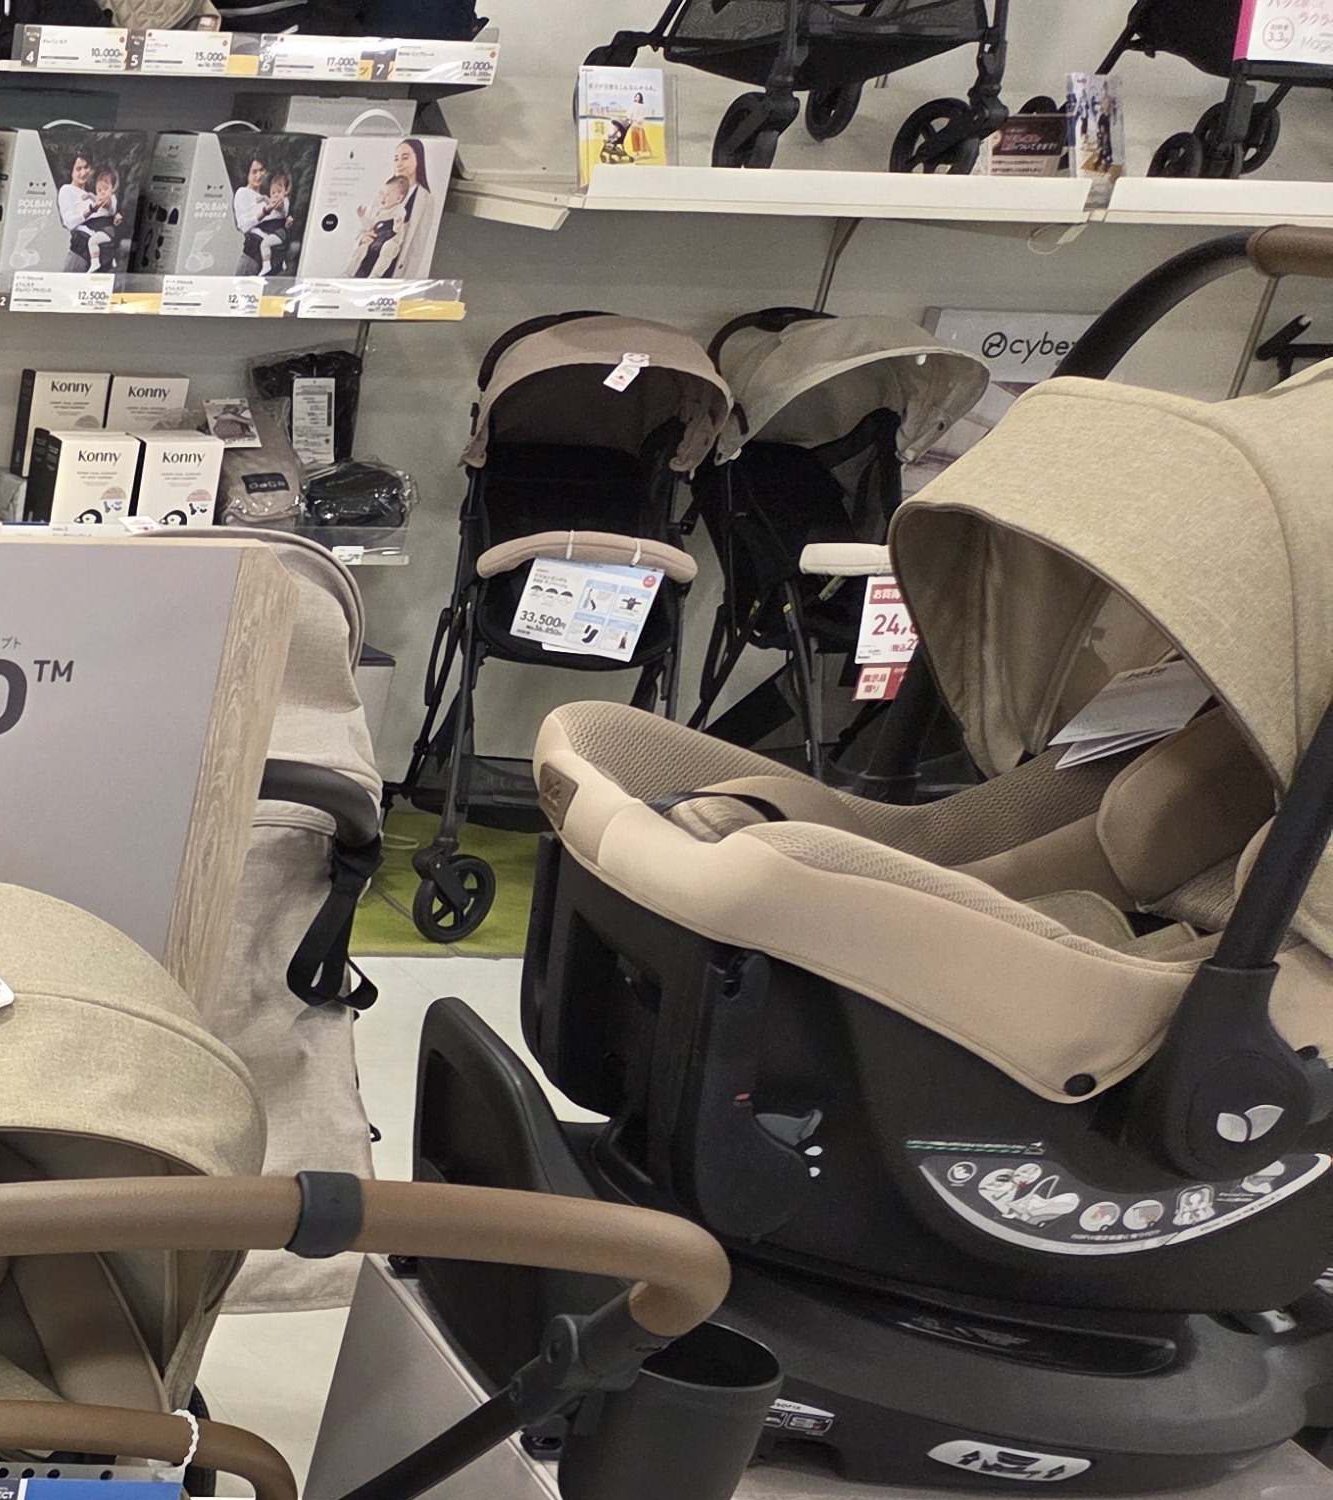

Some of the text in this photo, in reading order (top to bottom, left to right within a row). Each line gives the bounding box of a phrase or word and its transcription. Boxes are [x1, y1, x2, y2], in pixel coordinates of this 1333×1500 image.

[1009, 331, 1076, 364] cybe
[51, 380, 93, 396] Konny
[128, 385, 171, 402] Konny
[78, 449, 122, 466] Konny
[162, 451, 206, 467] Konny
[519, 610, 567, 630] 33,500円
